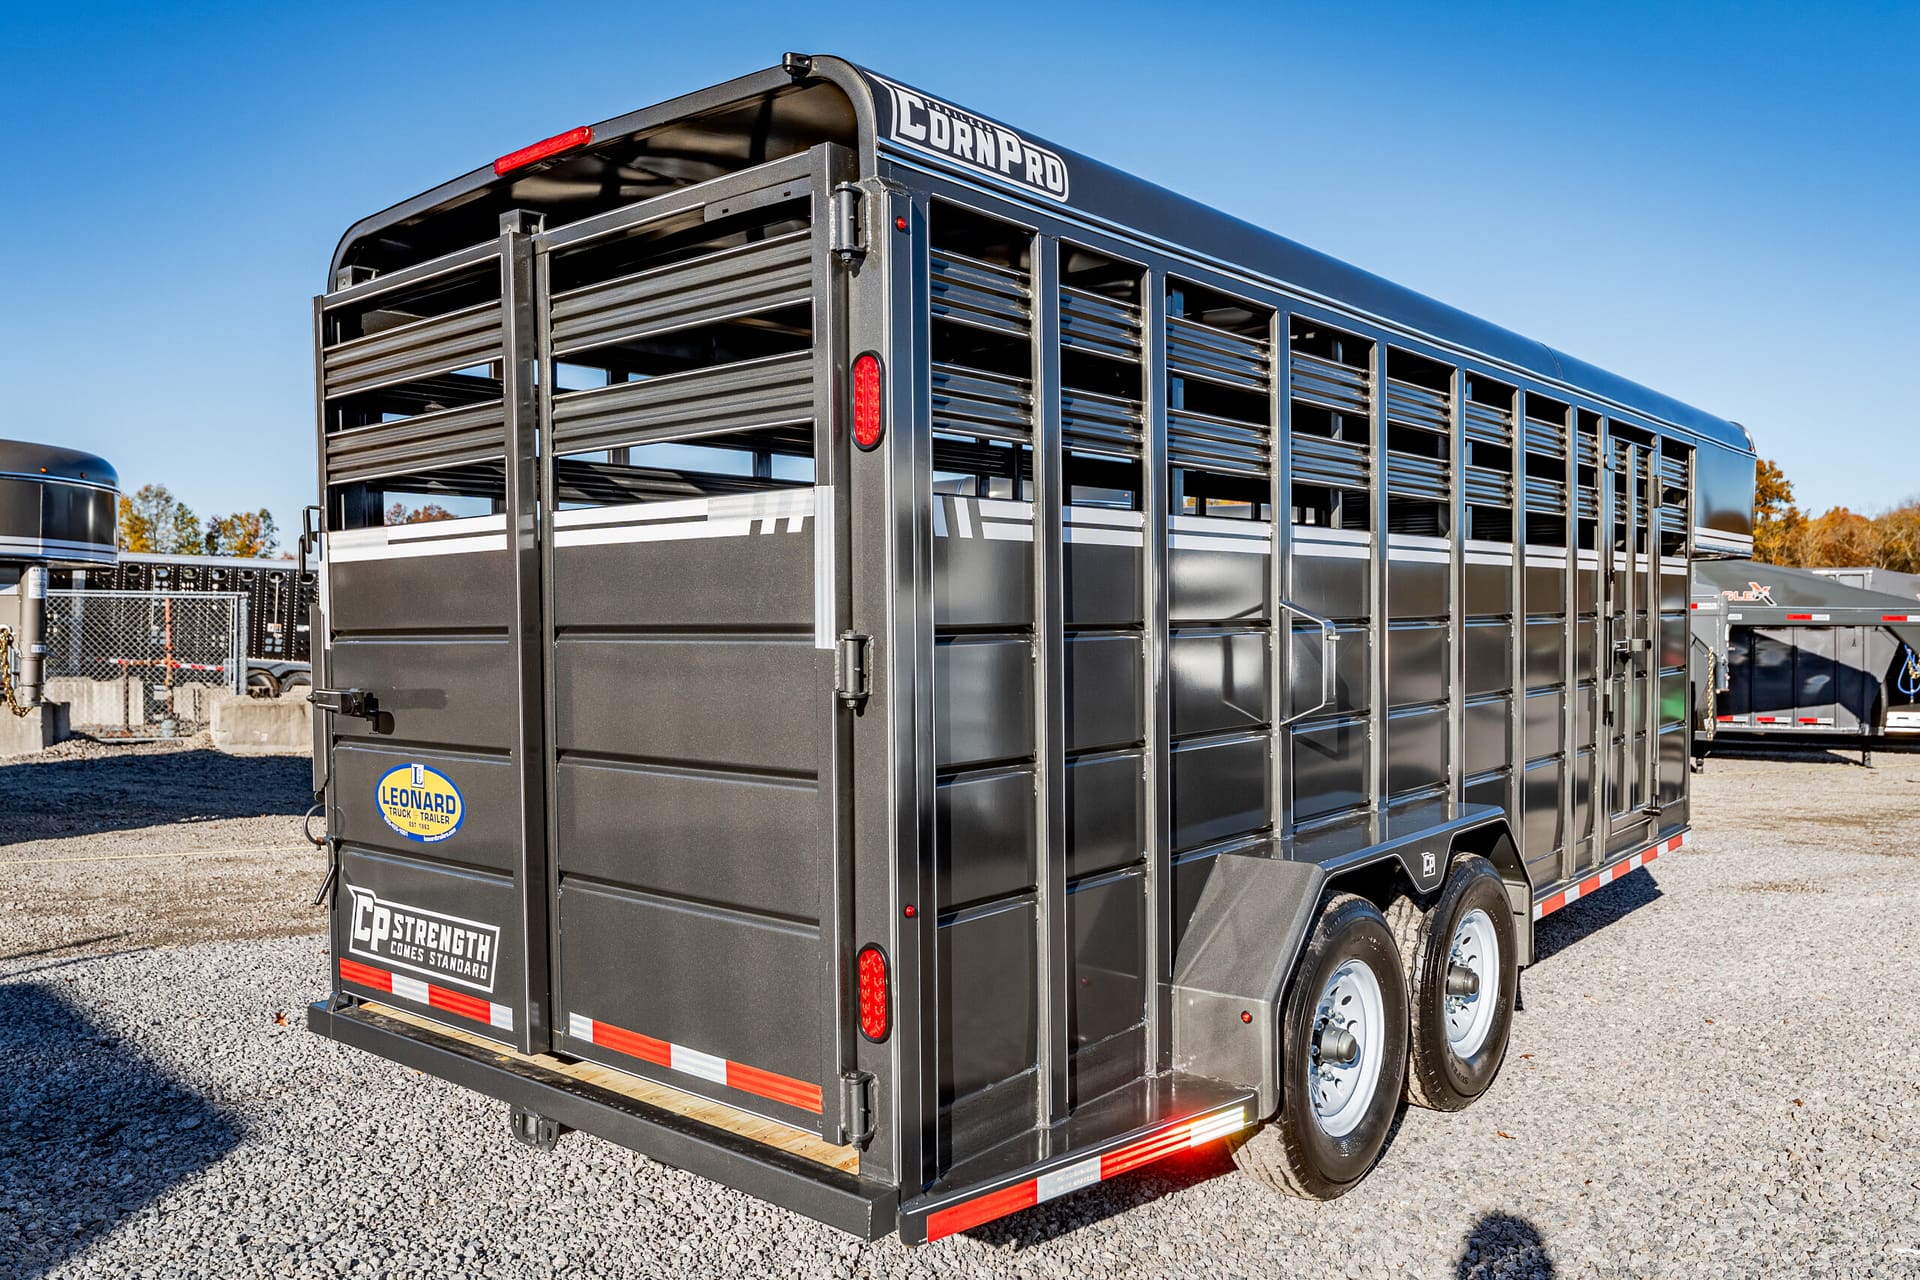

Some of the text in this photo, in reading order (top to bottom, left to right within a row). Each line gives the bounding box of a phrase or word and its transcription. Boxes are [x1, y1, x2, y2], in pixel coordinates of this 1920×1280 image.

[382, 786, 456, 815] LEONARD
[389, 806, 411, 819] TRUCK
[420, 811, 450, 825] TRAILER
[354, 894, 491, 963] CP STRENGTH
[390, 940, 488, 980] COMES STANDARD
